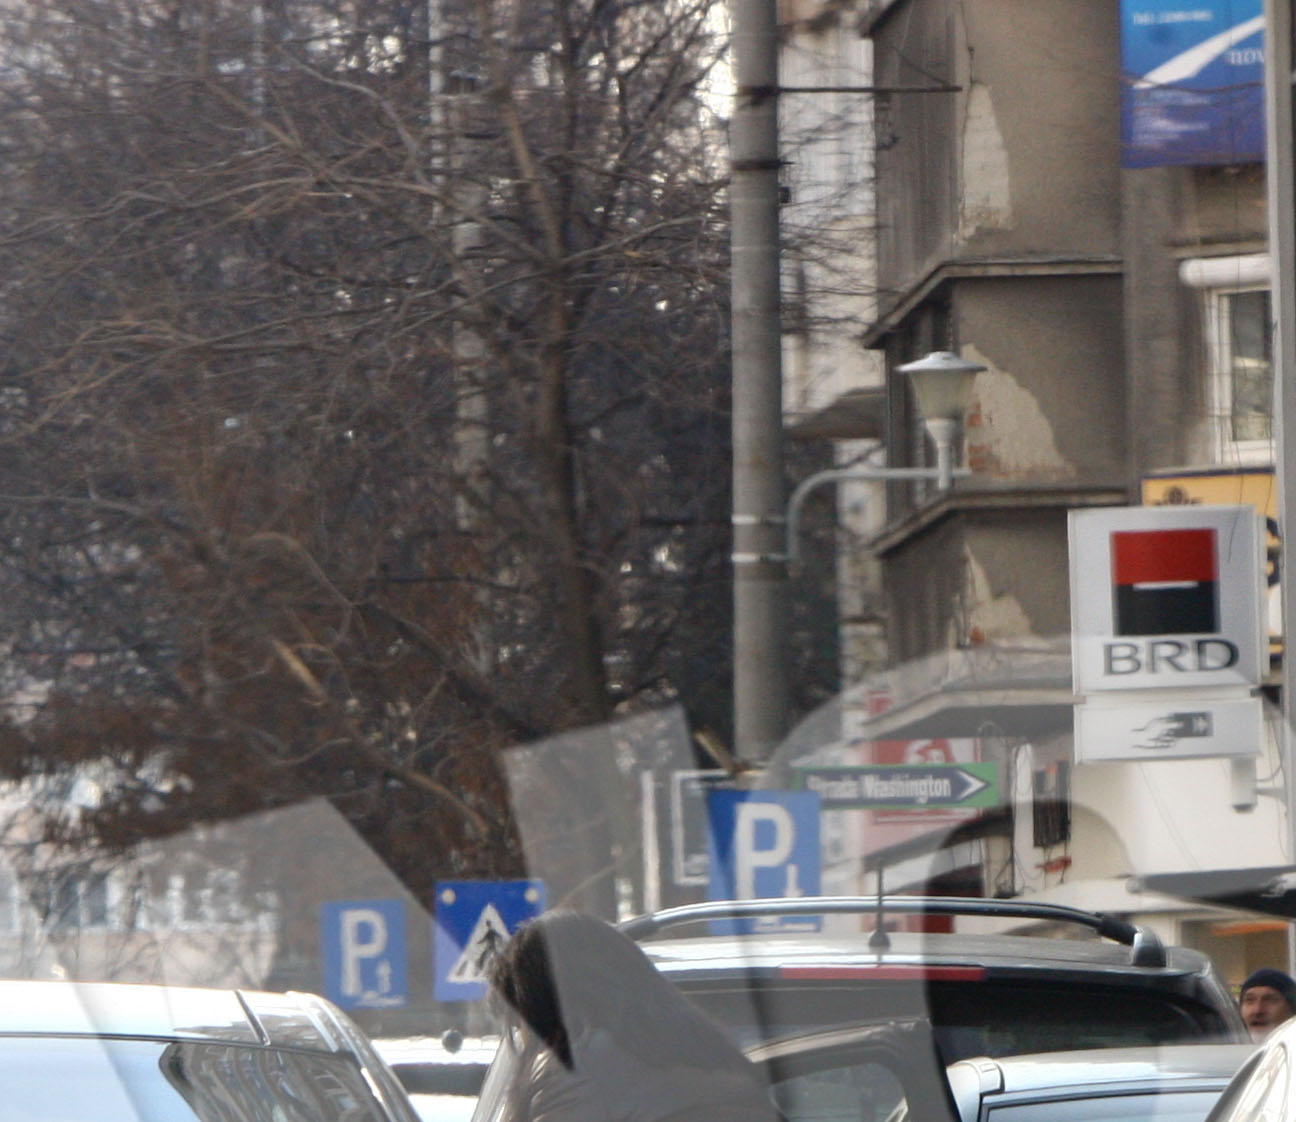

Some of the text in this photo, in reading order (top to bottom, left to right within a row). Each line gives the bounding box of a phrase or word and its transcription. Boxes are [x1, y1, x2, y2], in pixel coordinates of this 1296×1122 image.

[1104, 638, 1240, 675] BRD
[861, 773, 952, 804] Washington
[734, 802, 795, 900] P
[340, 908, 388, 996] P
